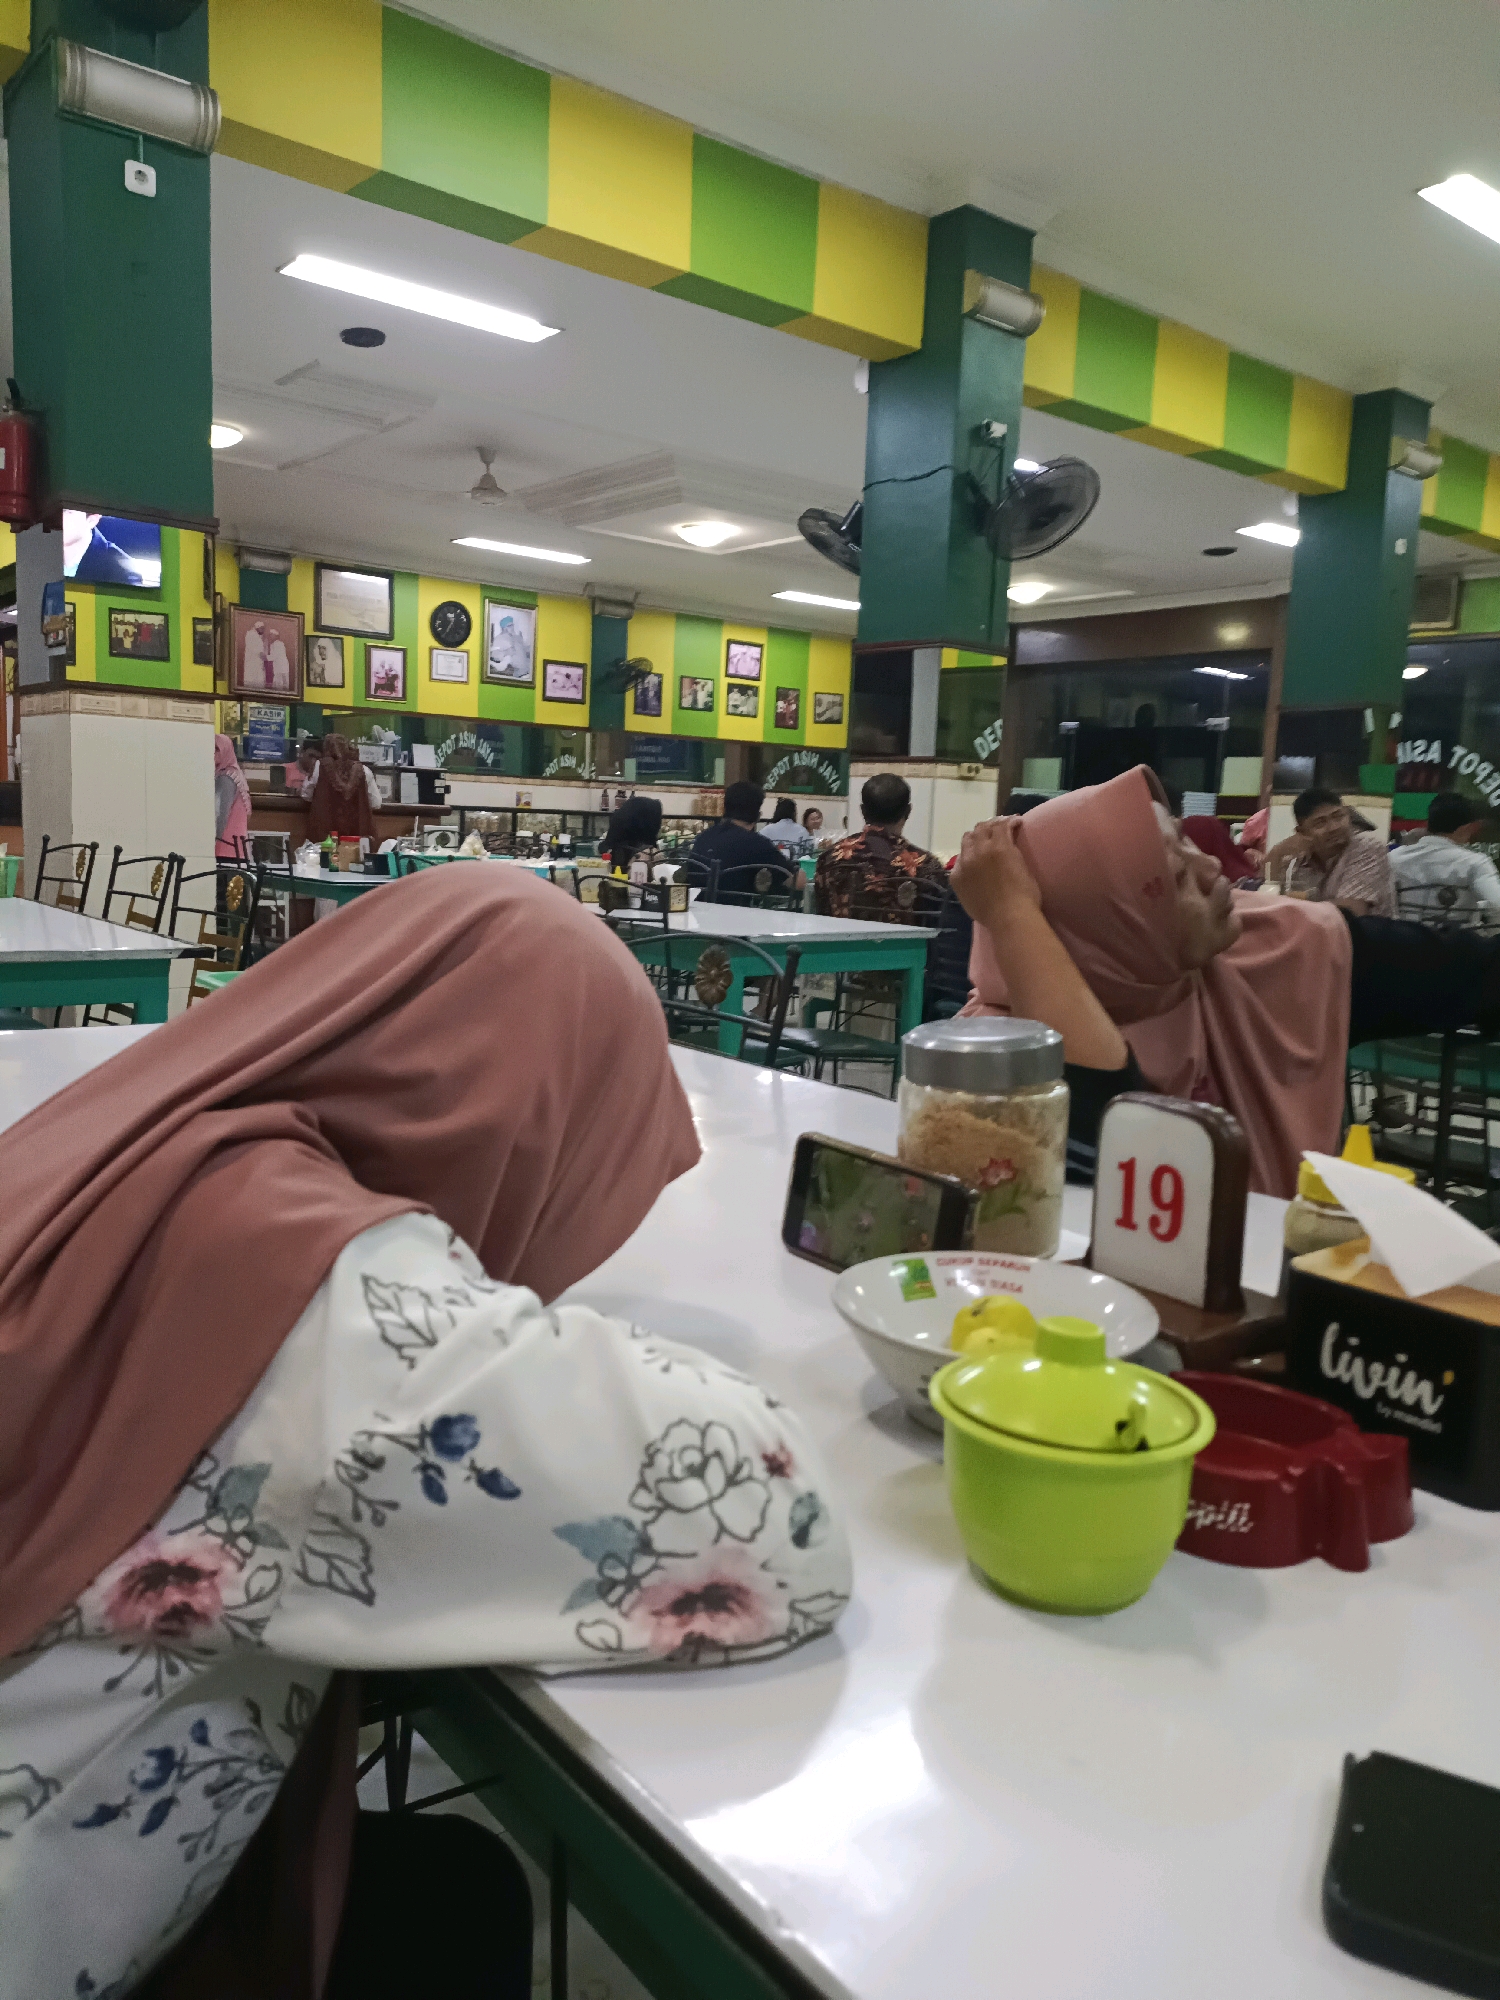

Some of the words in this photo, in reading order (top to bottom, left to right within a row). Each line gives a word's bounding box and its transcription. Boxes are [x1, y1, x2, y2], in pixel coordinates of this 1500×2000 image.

[257, 709, 282, 718] KASIR
[435, 733, 456, 768] DEPOT
[458, 730, 476, 750] ASIH
[477, 738, 494, 767] JAYA
[560, 754, 577, 769] ASIH
[763, 755, 790, 790] DEPOT
[793, 750, 819, 769] ASIH
[818, 760, 841, 793] JAYA
[1115, 1157, 1185, 1243] 19
